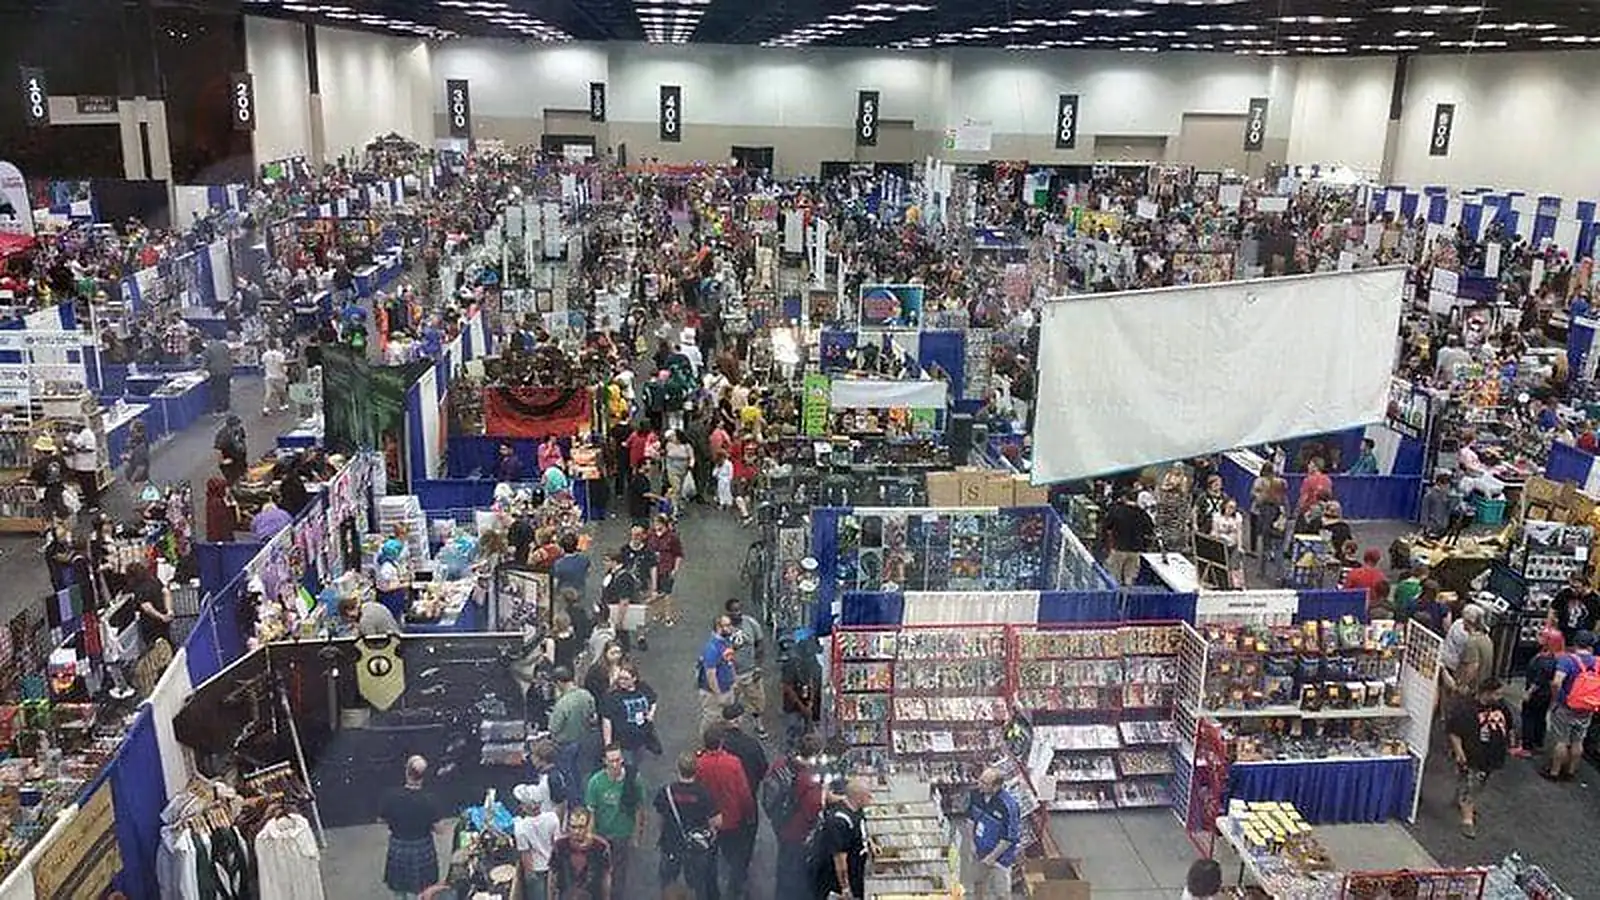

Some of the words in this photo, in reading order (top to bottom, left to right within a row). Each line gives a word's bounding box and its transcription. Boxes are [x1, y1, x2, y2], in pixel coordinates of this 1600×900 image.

[29, 79, 44, 118] 100
[237, 83, 249, 121] 200
[453, 90, 465, 127] 300
[665, 95, 675, 133] 400
[862, 100, 873, 137] 500
[1061, 104, 1072, 140] 600
[1250, 108, 1262, 143] 700
[967, 484, 980, 501] S
